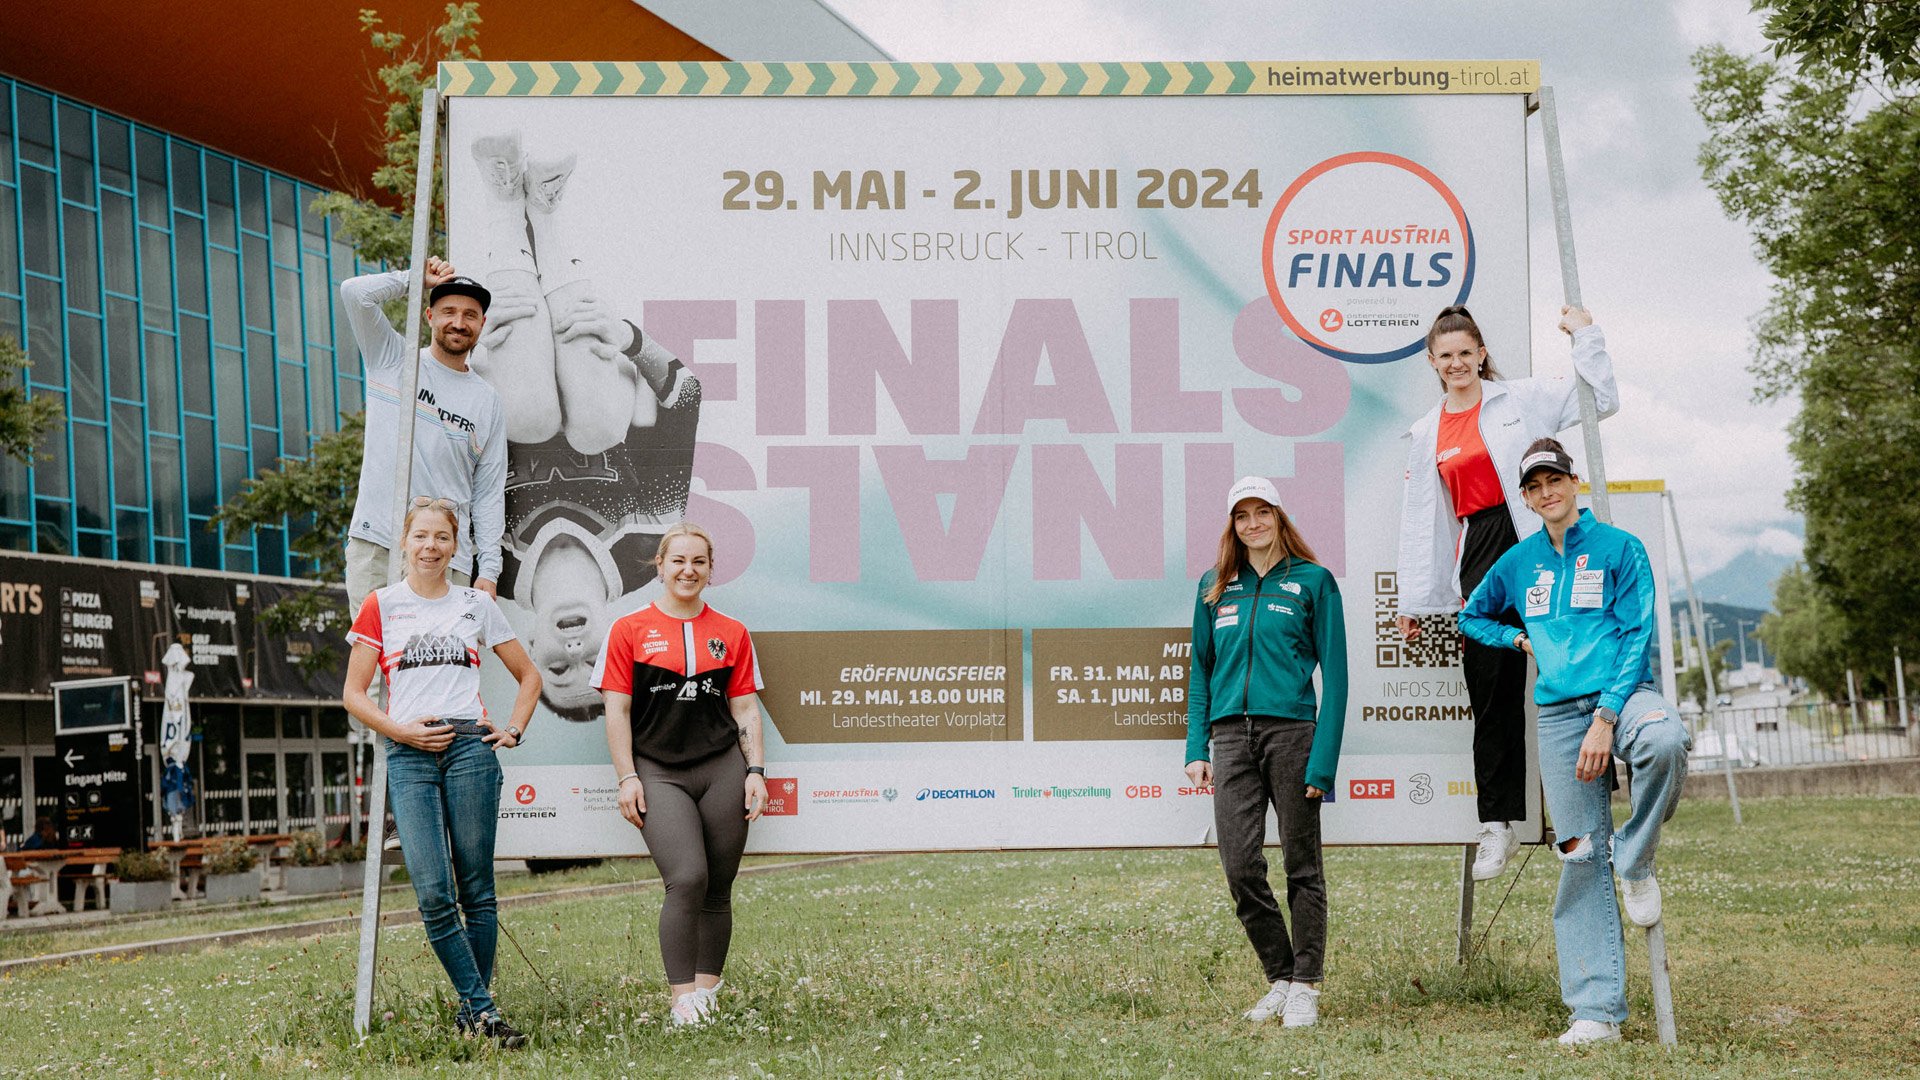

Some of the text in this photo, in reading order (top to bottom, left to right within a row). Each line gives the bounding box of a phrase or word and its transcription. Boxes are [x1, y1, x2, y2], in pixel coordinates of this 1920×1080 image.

[1268, 66, 1530, 91] heimatwerbung-tirol.at
[722, 170, 798, 211] 29.
[812, 170, 907, 210] MAI
[953, 169, 995, 210] 2.
[1006, 168, 1118, 219] JUNI
[1136, 168, 1263, 209] 2024
[1287, 224, 1451, 246] SPORT AUSTRIA
[829, 231, 1025, 262] INNSBRUCK
[1061, 230, 1158, 261] TIROL
[1288, 252, 1454, 289] FINALS
[1347, 319, 1419, 327] LOTTERIEN
[643, 296, 1353, 438] FINALS
[72, 592, 101, 609] PIZZA
[72, 613, 113, 630] BURGER
[73, 633, 104, 649] PASTA
[407, 646, 466, 664] AUSTRIA
[840, 664, 1006, 683] ERÖFFNUNGSFEIER
[1050, 665, 1184, 682] FR. 31. MAI, AB
[800, 688, 1005, 706] MI. 29. MAI, 18.00 UHR
[1057, 688, 1184, 706] SA. 1. JUNI, AB
[1383, 681, 1431, 698] INFOS
[833, 711, 1006, 729] Landestheater Vorplatz
[1362, 705, 1473, 721] PROGRAMM
[65, 770, 127, 788] Eingang Mitte
[812, 787, 879, 798] SPORT AUSTRIA
[932, 789, 995, 799] DECATHLON
[1012, 786, 1111, 800] Tiroler Tageszeitung
[1125, 785, 1162, 799] ÖBB
[1352, 783, 1392, 796] ORF
